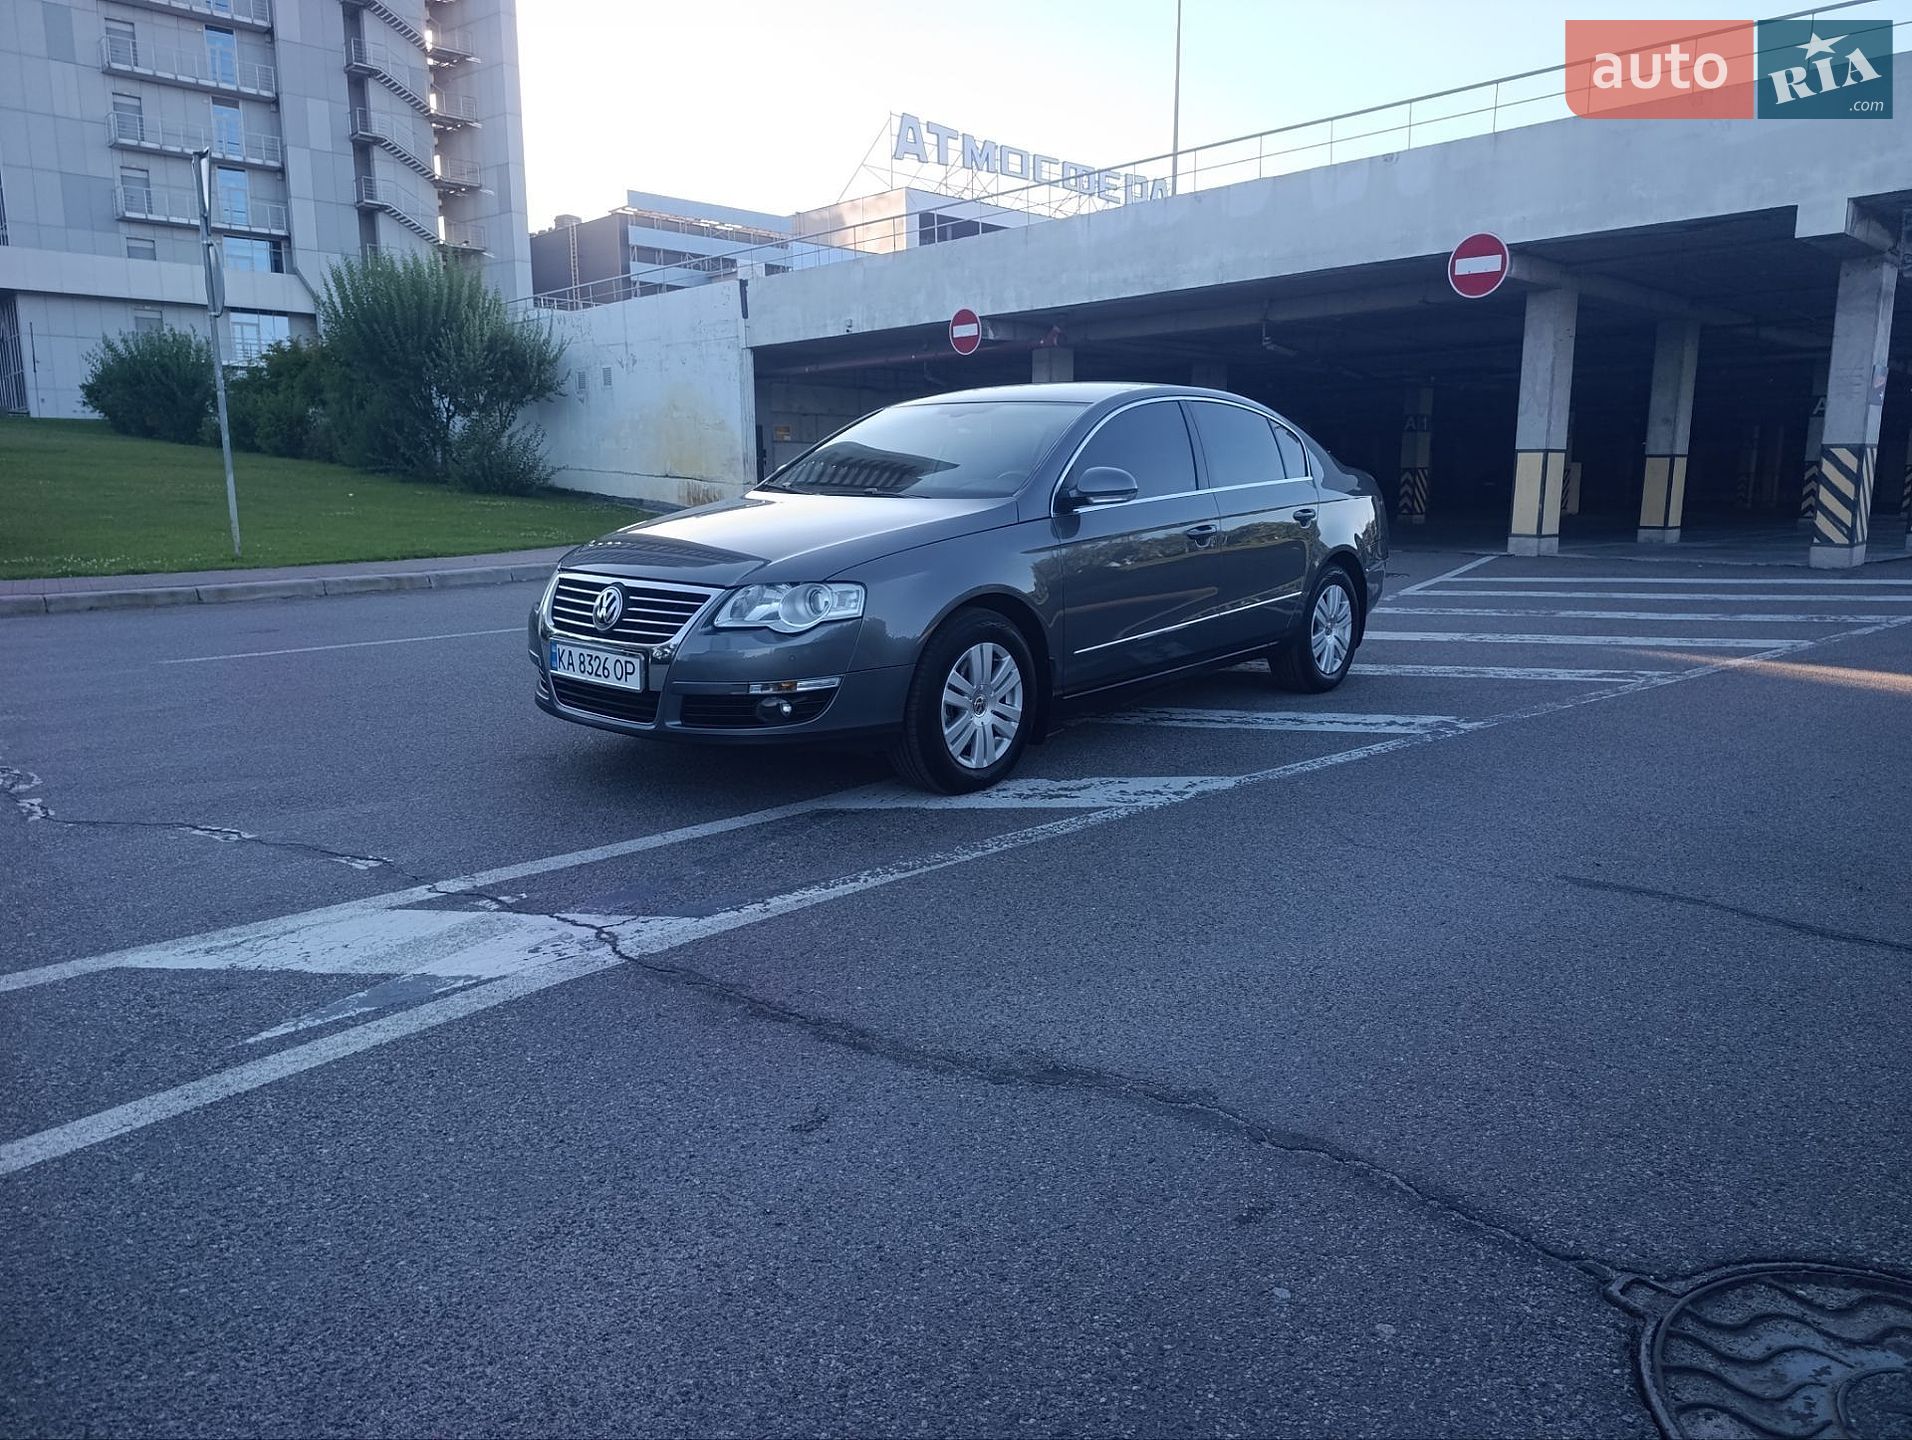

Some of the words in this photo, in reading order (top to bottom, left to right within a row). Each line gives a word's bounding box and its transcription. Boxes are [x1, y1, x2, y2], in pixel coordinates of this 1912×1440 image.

[894, 113, 1168, 205] АТМОСФЕРА
[557, 647, 576, 672] KA
[578, 652, 611, 679] 8326
[613, 659, 636, 682] OP
